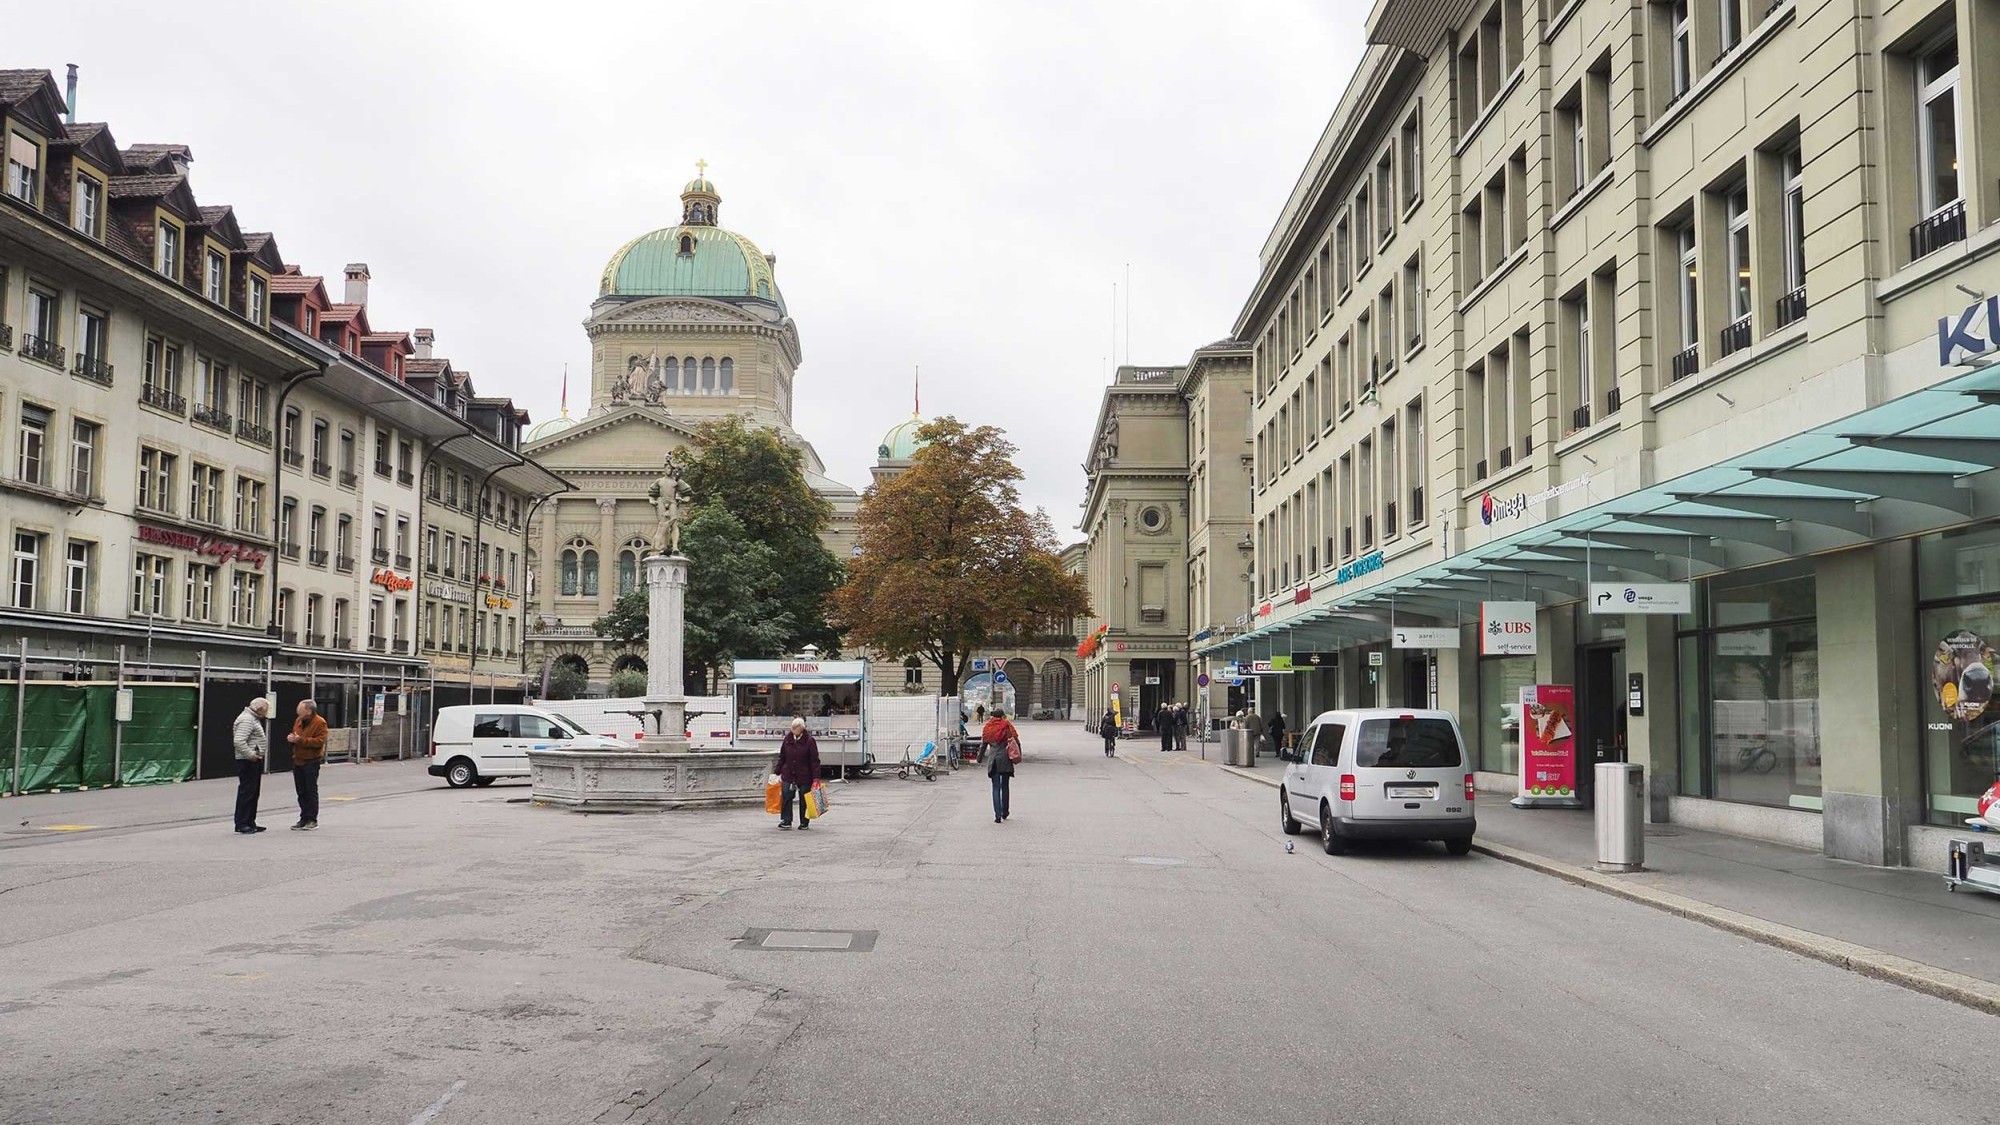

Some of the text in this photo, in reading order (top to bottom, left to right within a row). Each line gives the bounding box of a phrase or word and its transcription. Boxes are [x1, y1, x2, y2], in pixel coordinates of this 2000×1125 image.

[1493, 493, 1526, 521] omega
[139, 525, 199, 552] BRASSERIE
[1504, 622, 1532, 634] UBS
